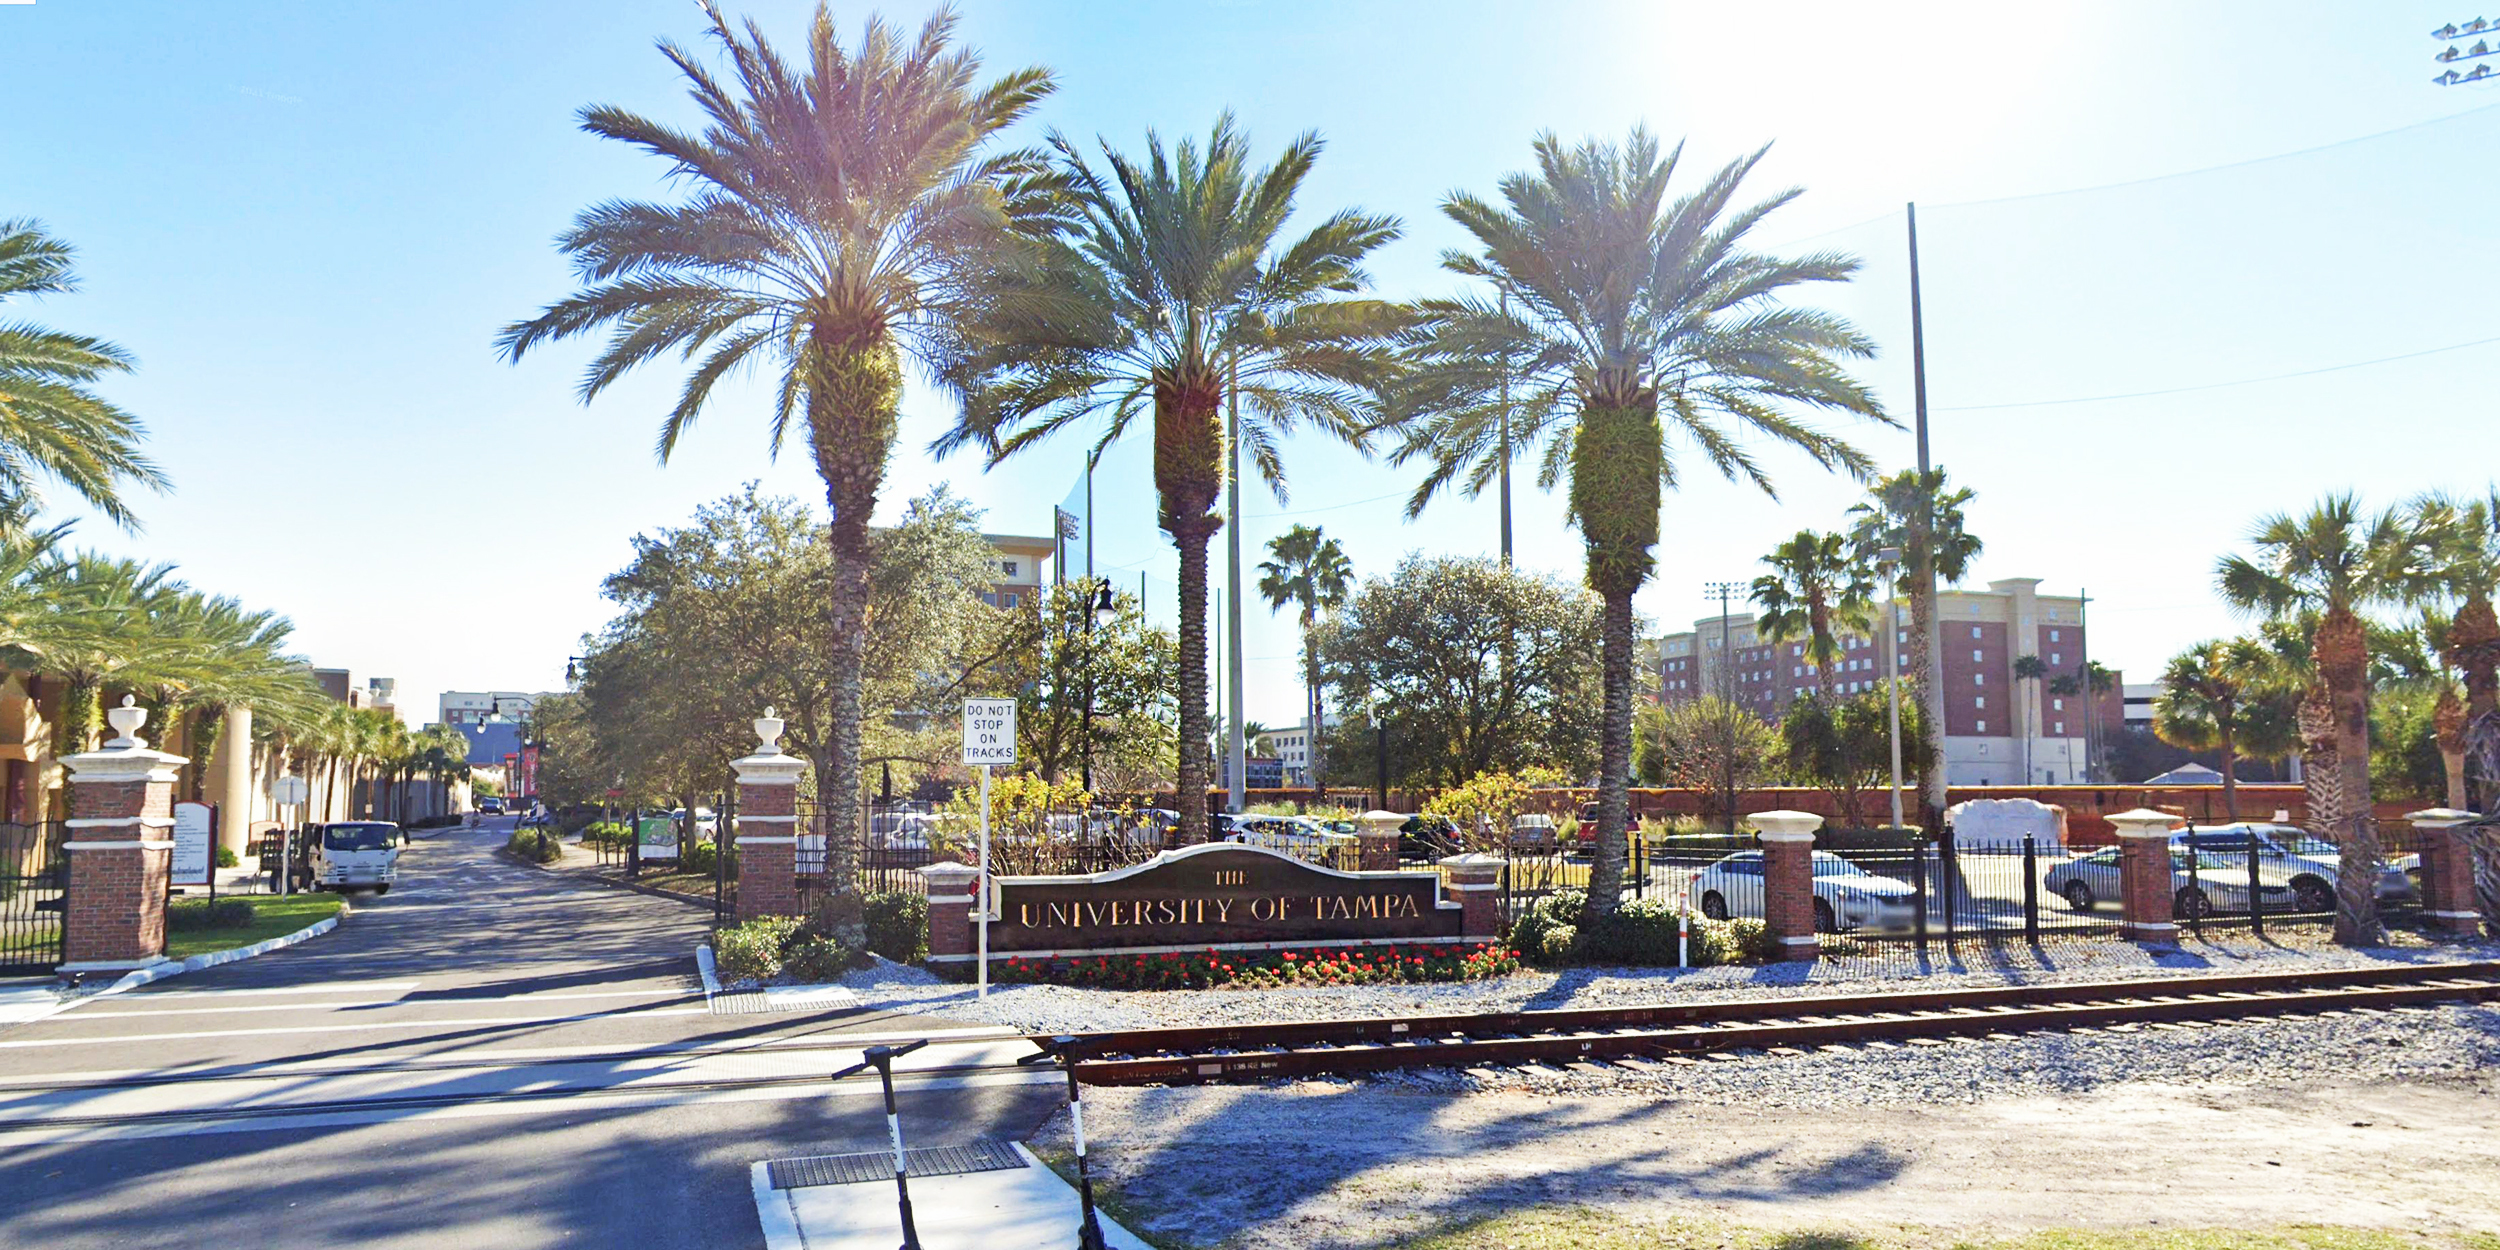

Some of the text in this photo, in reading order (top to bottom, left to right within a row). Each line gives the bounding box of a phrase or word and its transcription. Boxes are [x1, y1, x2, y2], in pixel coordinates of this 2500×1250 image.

[968, 705, 1012, 716] DO NOT
[974, 719, 1003, 730] STOP
[980, 733, 997, 744] ON
[966, 747, 1013, 758] TRACKS
[1214, 870, 1249, 886] THE
[1021, 893, 1420, 928] UNIVERSITY OF TAMPA
